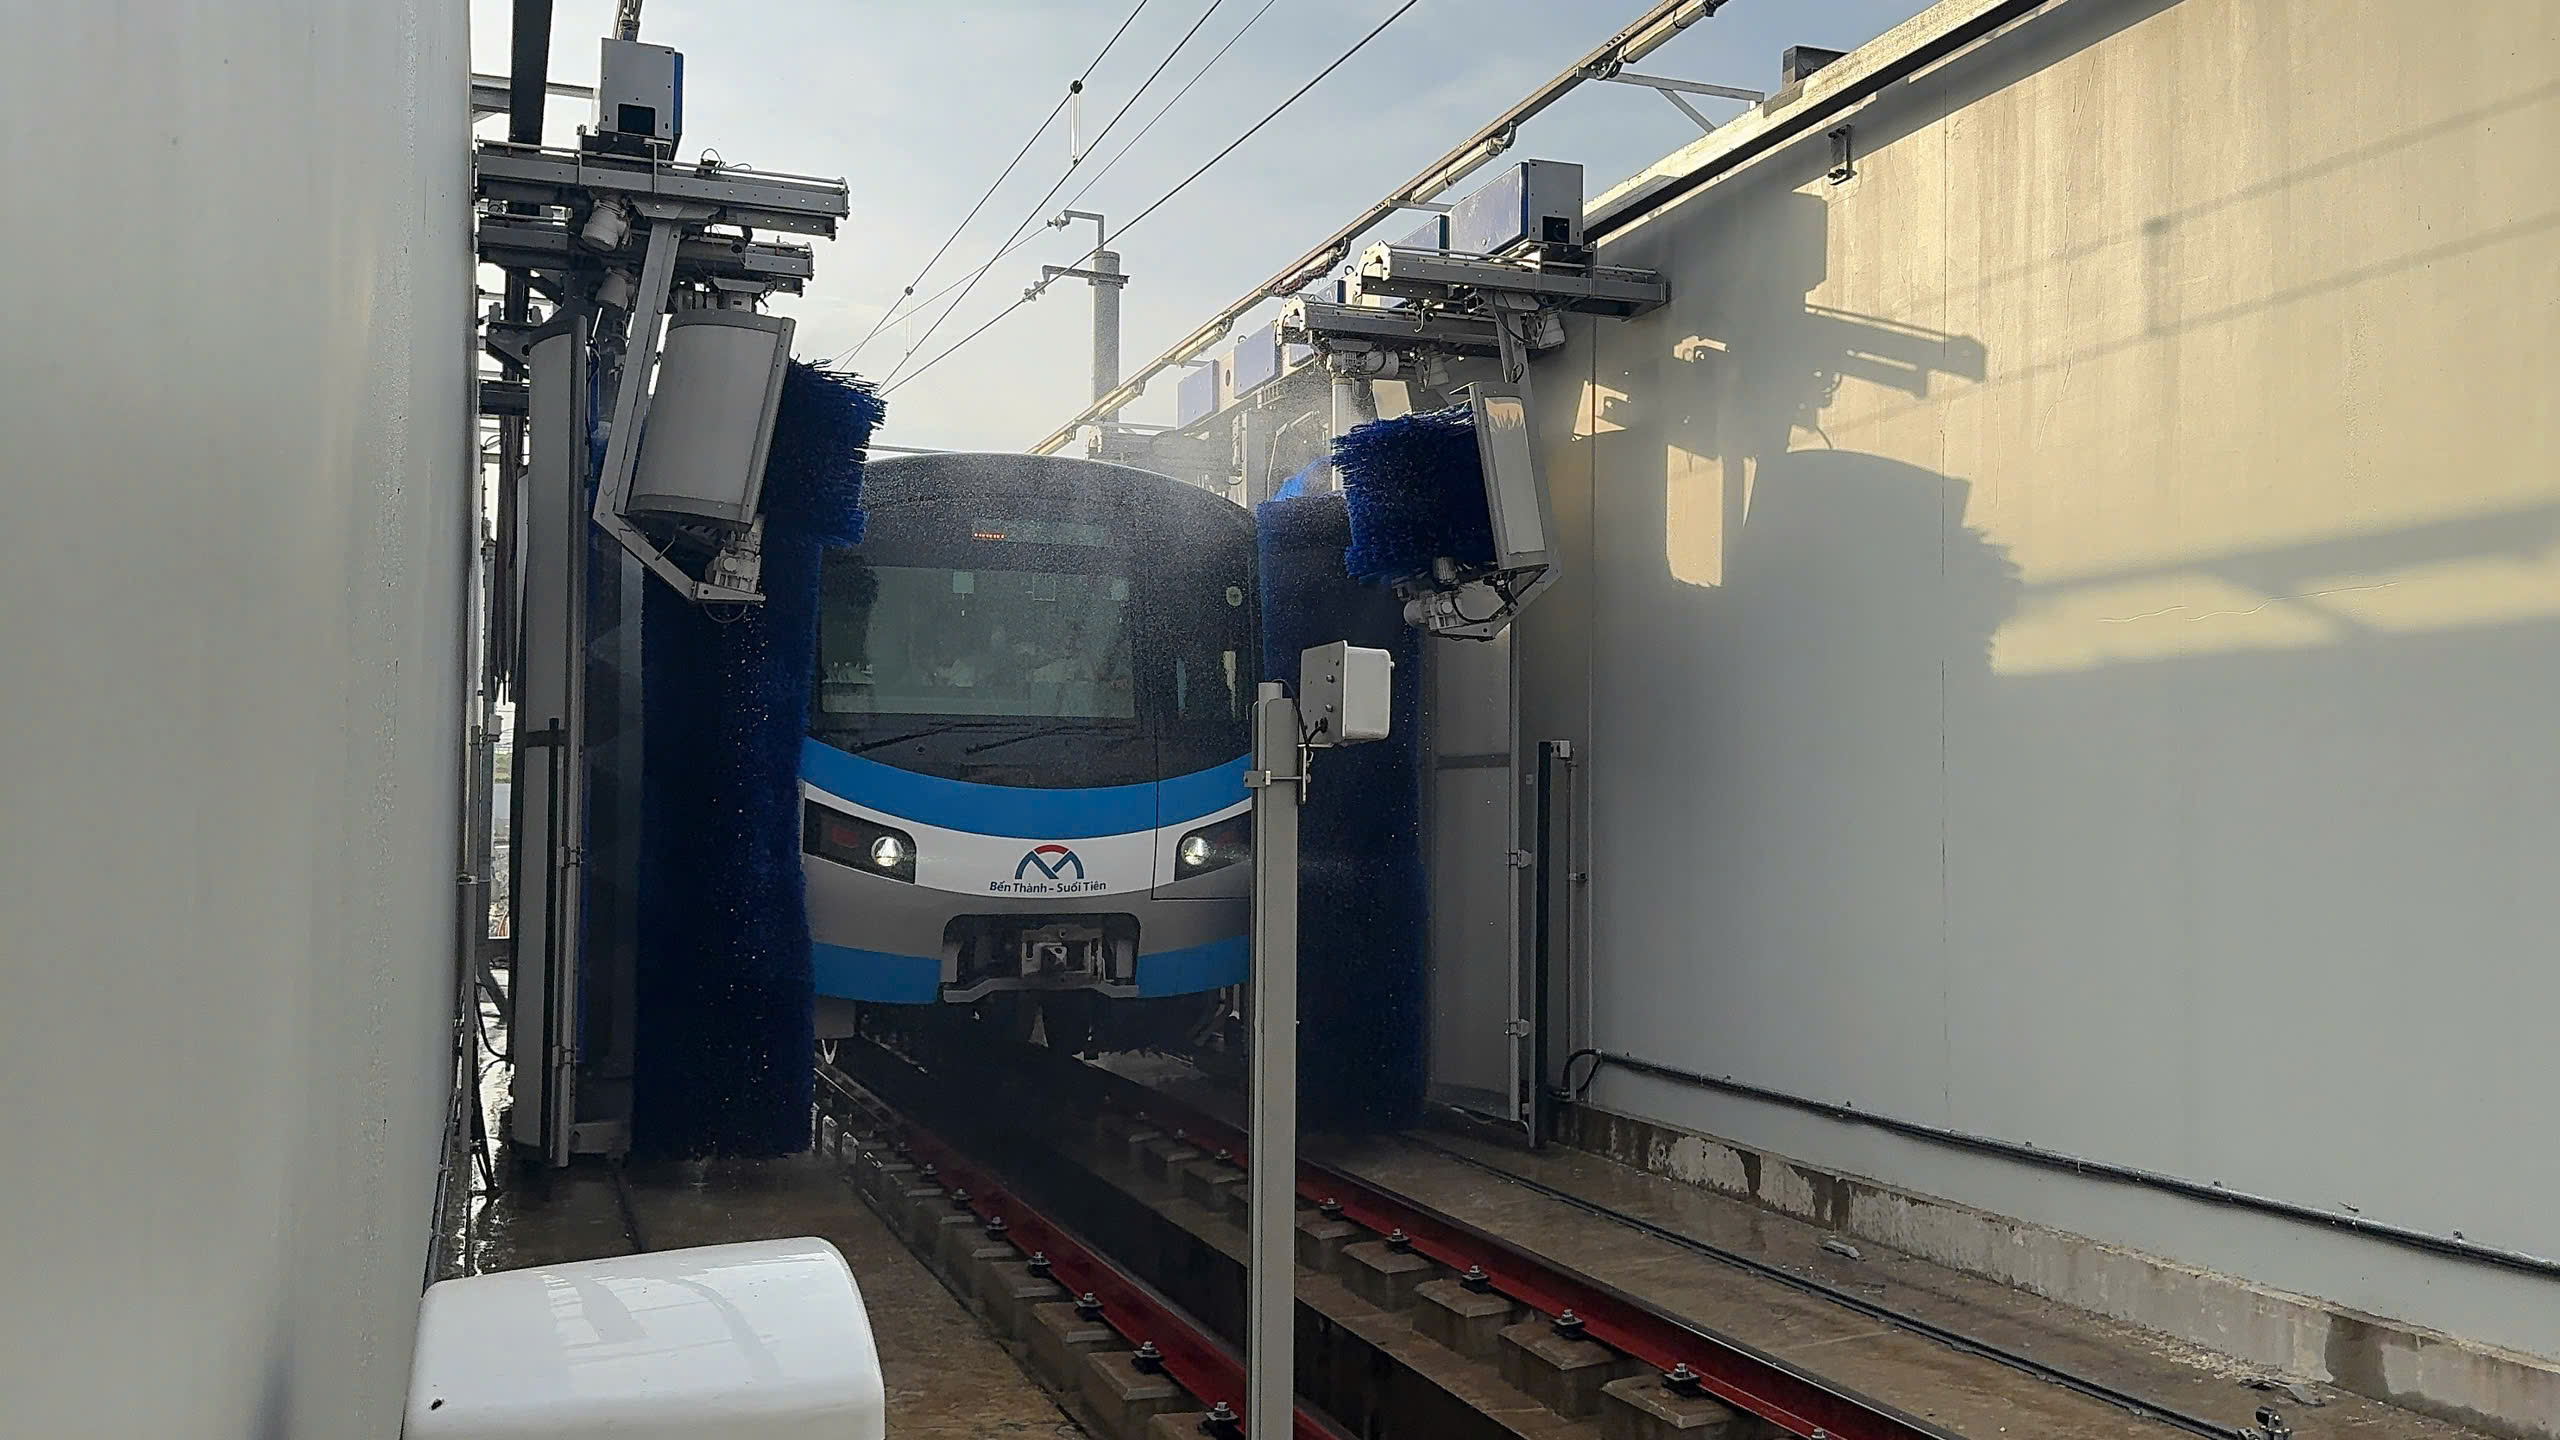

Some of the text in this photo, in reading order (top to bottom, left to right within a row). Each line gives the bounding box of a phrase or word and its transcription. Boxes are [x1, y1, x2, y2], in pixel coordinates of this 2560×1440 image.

[989, 880, 1011, 892] Bến
[1013, 882, 1048, 893] Thành
[1056, 881, 1081, 893] Suối
[1082, 880, 1107, 892] Tiên
